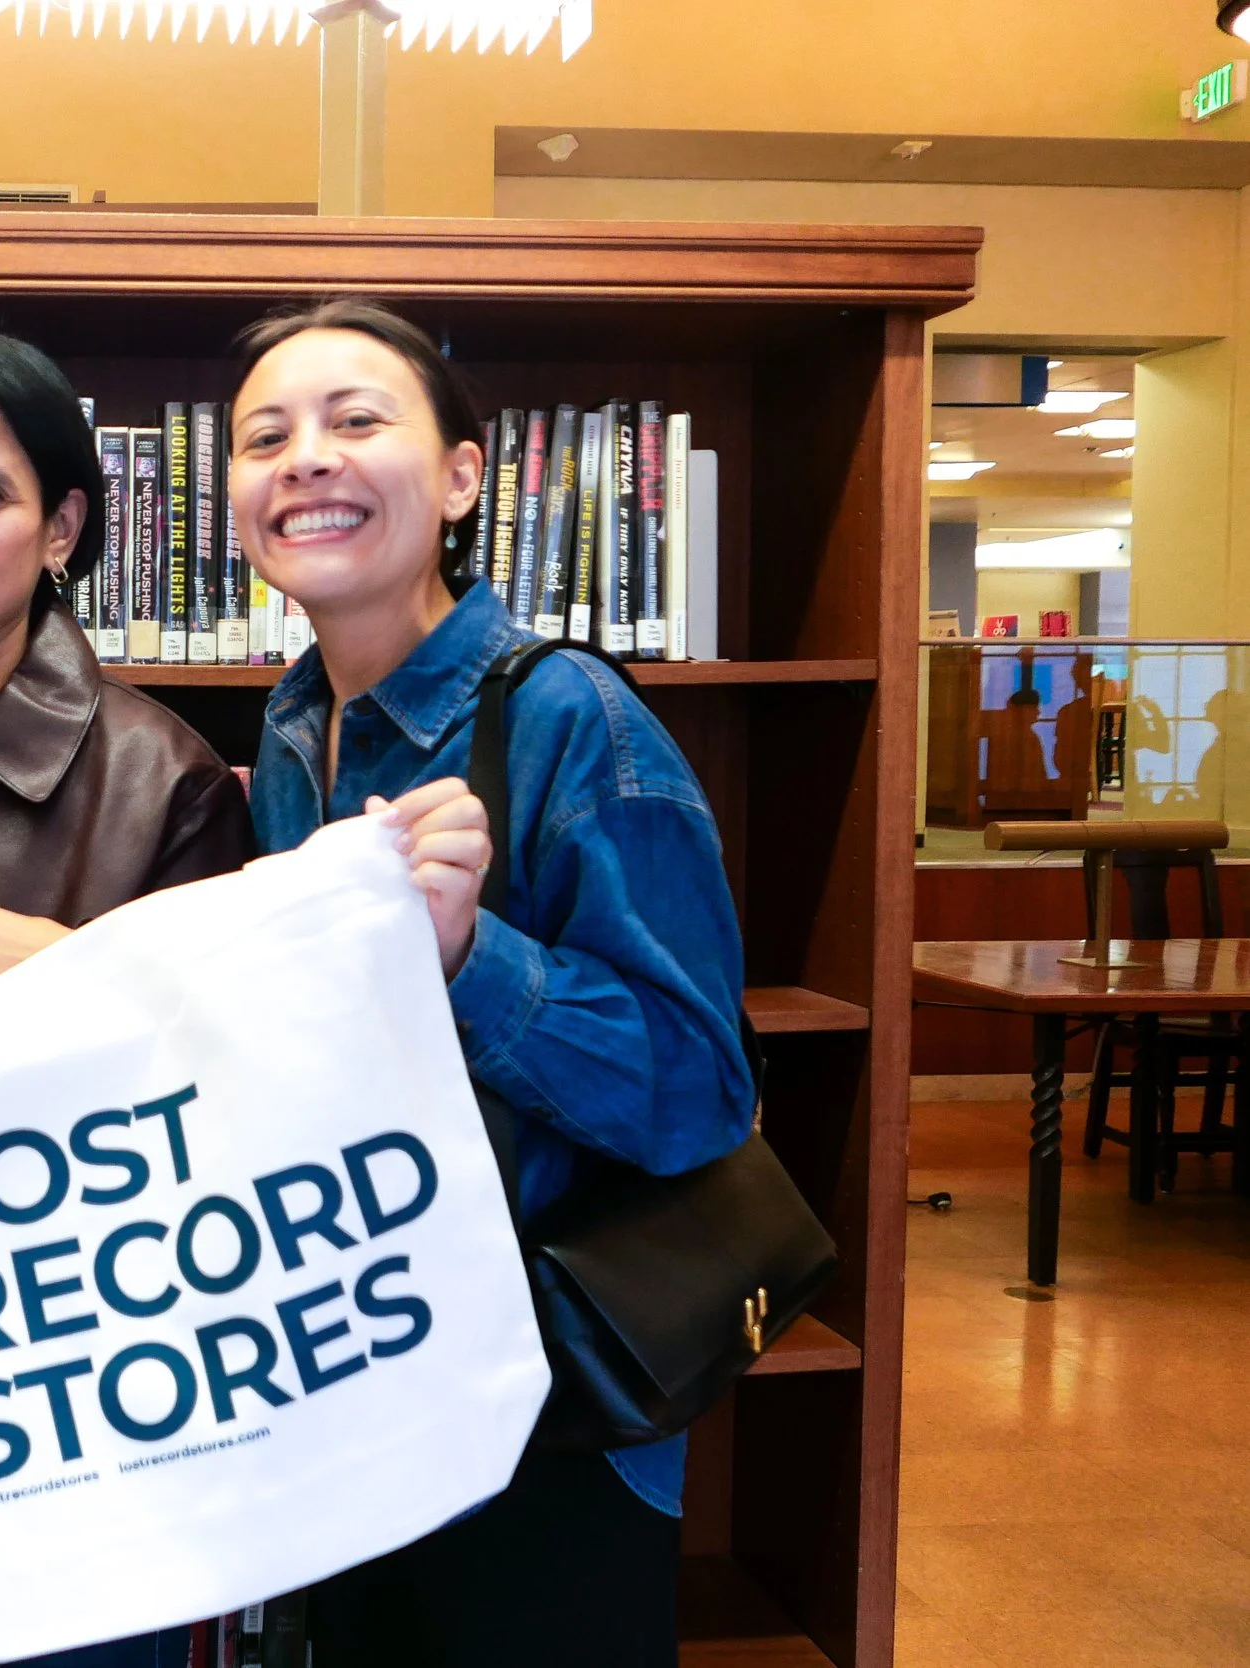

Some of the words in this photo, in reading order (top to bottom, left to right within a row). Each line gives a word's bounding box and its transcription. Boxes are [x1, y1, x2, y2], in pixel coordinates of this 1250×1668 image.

[1197, 63, 1233, 119] EXIT
[642, 411, 661, 423] THE
[171, 415, 187, 487] LOOKING
[197, 413, 213, 495] GORGEOUS
[562, 445, 572, 459] THE
[619, 424, 634, 495] CHYNA
[560, 459, 575, 491] ROCK
[110, 478, 120, 522] NEVER
[142, 481, 153, 525] NEVER
[171, 494, 187, 513] AT
[496, 462, 518, 522] TREVON
[582, 489, 593, 521] LIFE
[196, 498, 213, 560] GEORGE
[525, 523, 534, 531] IS
[619, 507, 629, 519] IF
[647, 516, 657, 534] CHRIS
[109, 525, 120, 558] STOP
[141, 528, 152, 560] STOP
[170, 519, 186, 549] THE
[525, 534, 533, 542] A
[580, 525, 592, 539] IS
[619, 523, 629, 552] THEY
[648, 535, 657, 553] LEBEN
[492, 524, 513, 581] JENIFER
[170, 557, 186, 614] LIGHTS
[193, 576, 206, 594] John
[516, 543, 535, 613] FOUR-LETTER
[545, 561, 564, 593] Rock
[577, 543, 591, 604] FIGHTIN
[618, 555, 629, 586] ONLY
[648, 566, 657, 587] DANIEL
[109, 560, 120, 620] PUSHING
[196, 596, 211, 629] Capouya
[619, 589, 629, 624] KNEW
[117, 1424, 272, 1475] lostrecordstores.com
